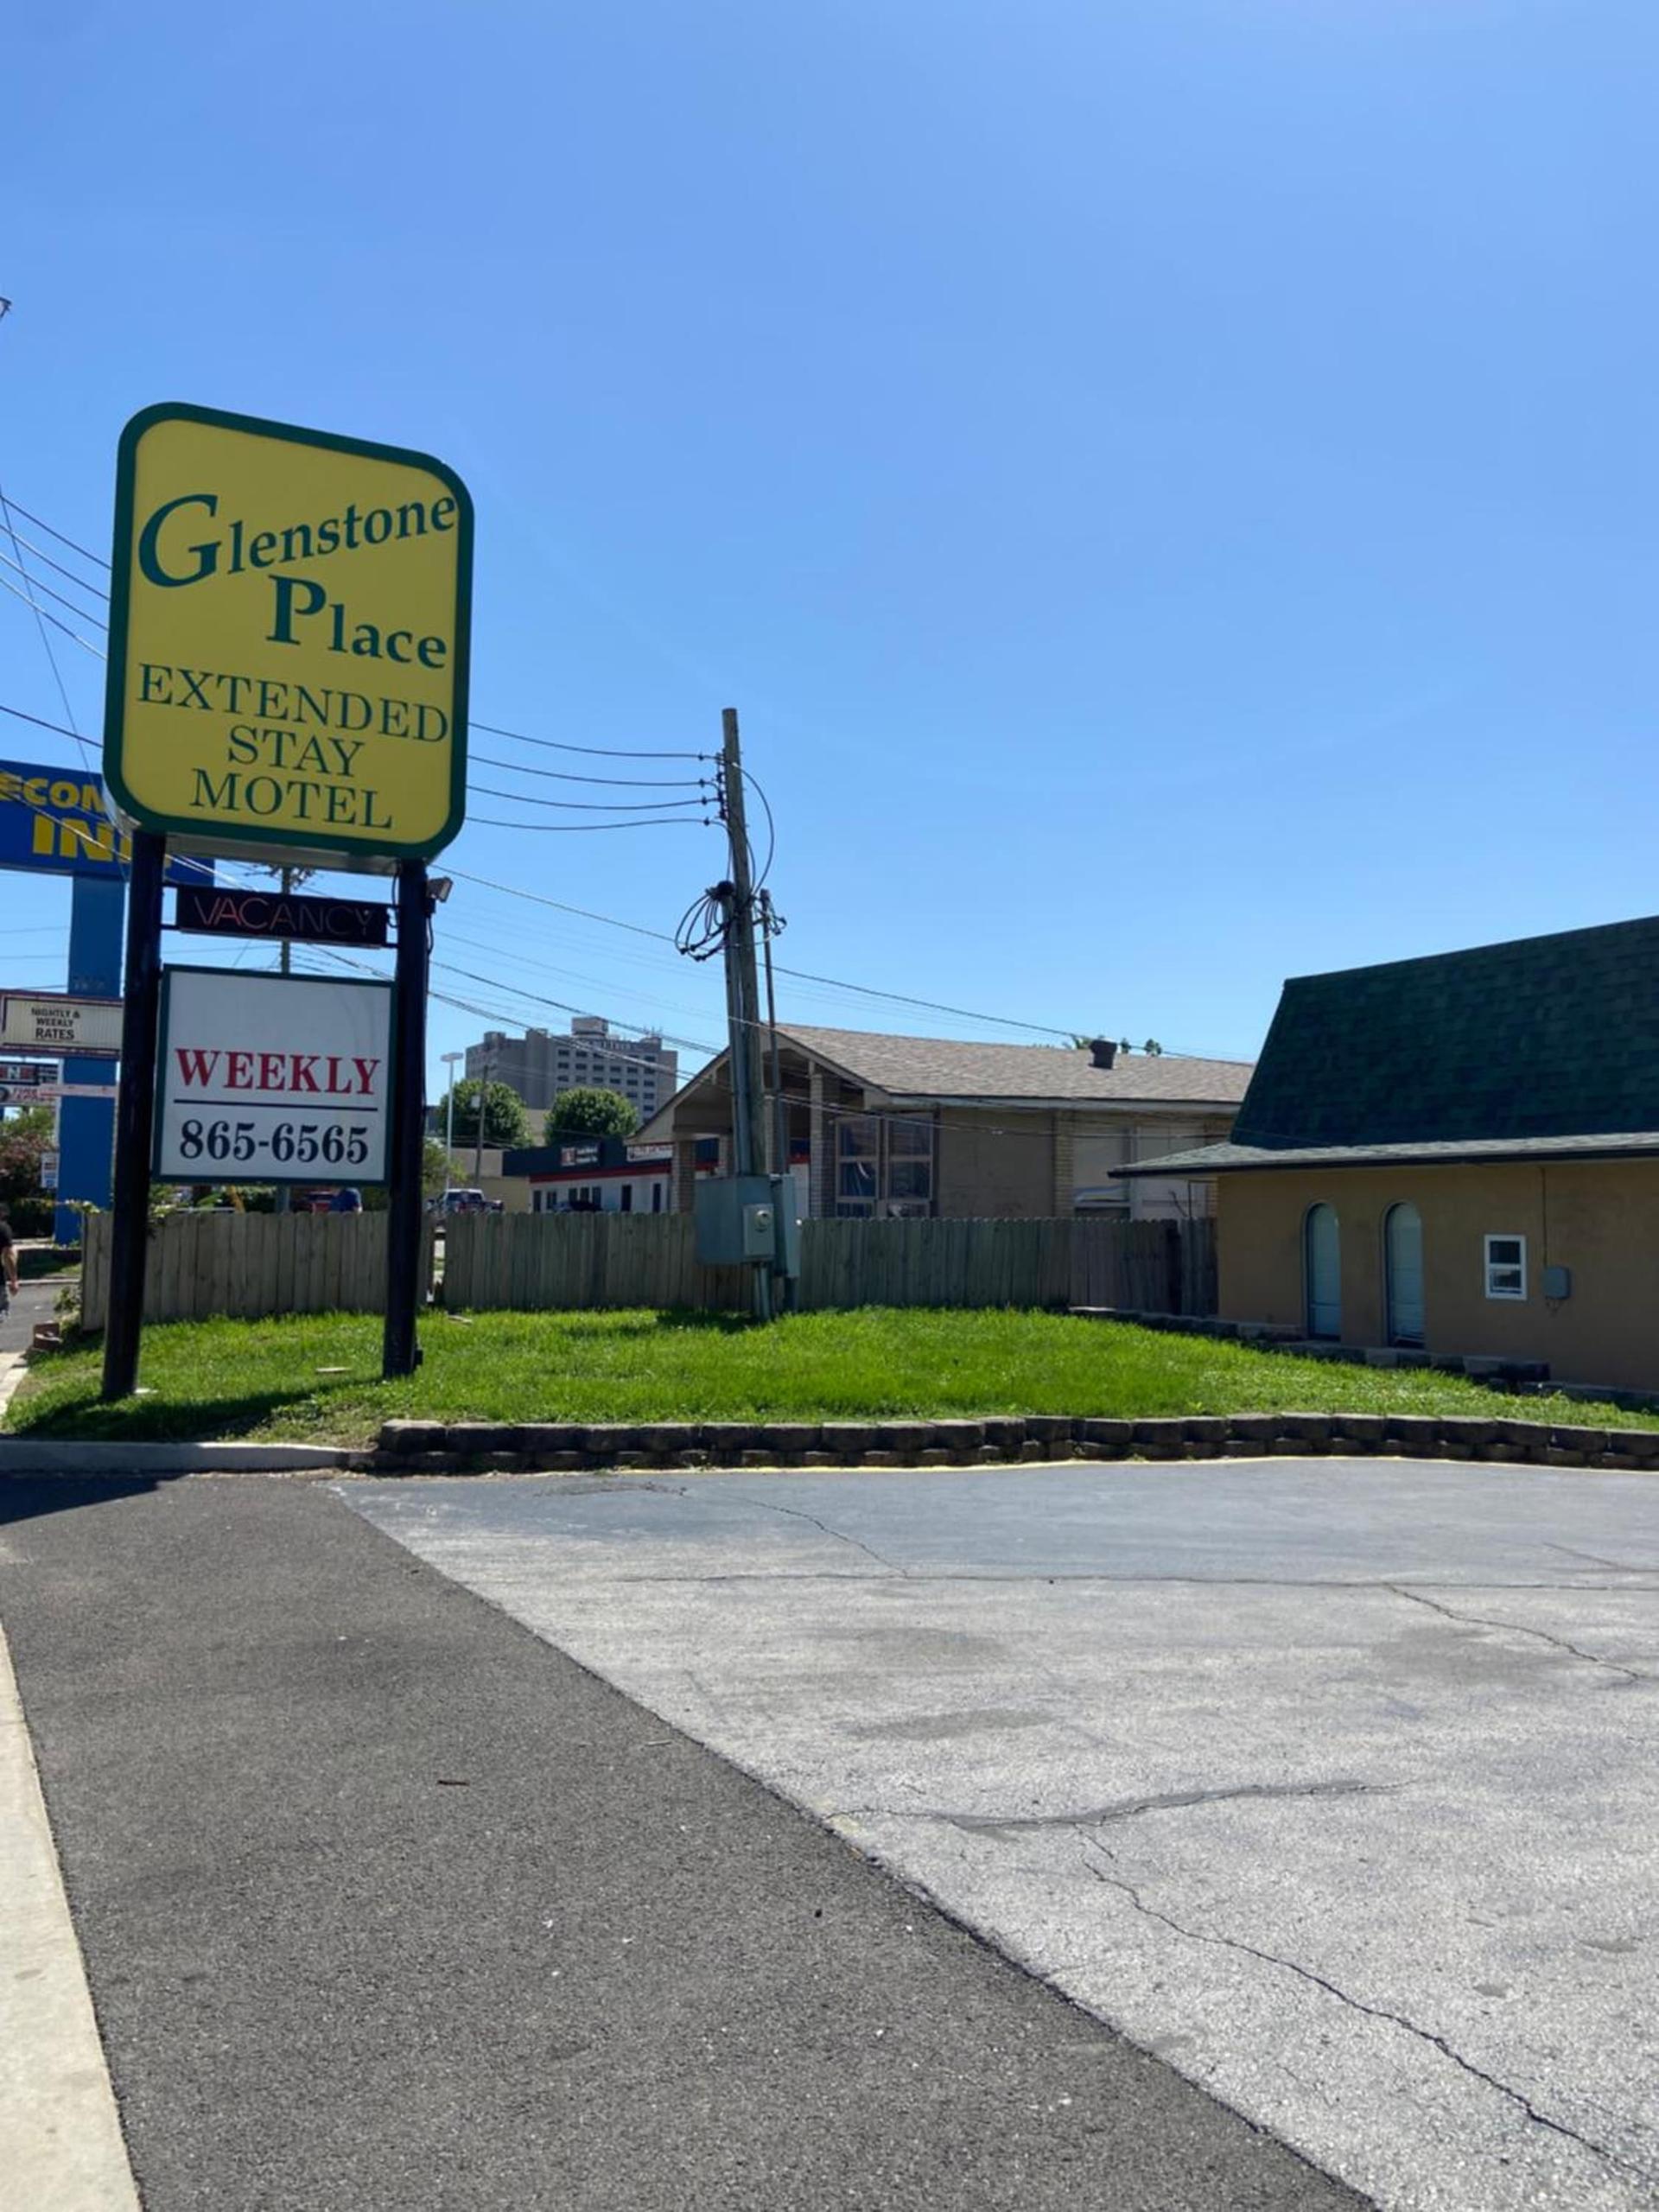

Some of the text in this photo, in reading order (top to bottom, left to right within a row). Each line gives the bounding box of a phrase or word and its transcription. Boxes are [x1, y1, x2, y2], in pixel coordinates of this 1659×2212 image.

[139, 493, 456, 588] Glenstone
[266, 574, 447, 669] Place
[137, 663, 449, 743] EXTENDED
[227, 725, 365, 778] STAY
[189, 768, 393, 830] MOTEL
[194, 895, 373, 937] VACANCY
[35, 1028, 75, 1039] RATES
[36, 1018, 73, 1027] WEEKLY
[175, 1047, 382, 1096] WEEKLY
[179, 1118, 369, 1166] 865-6565
